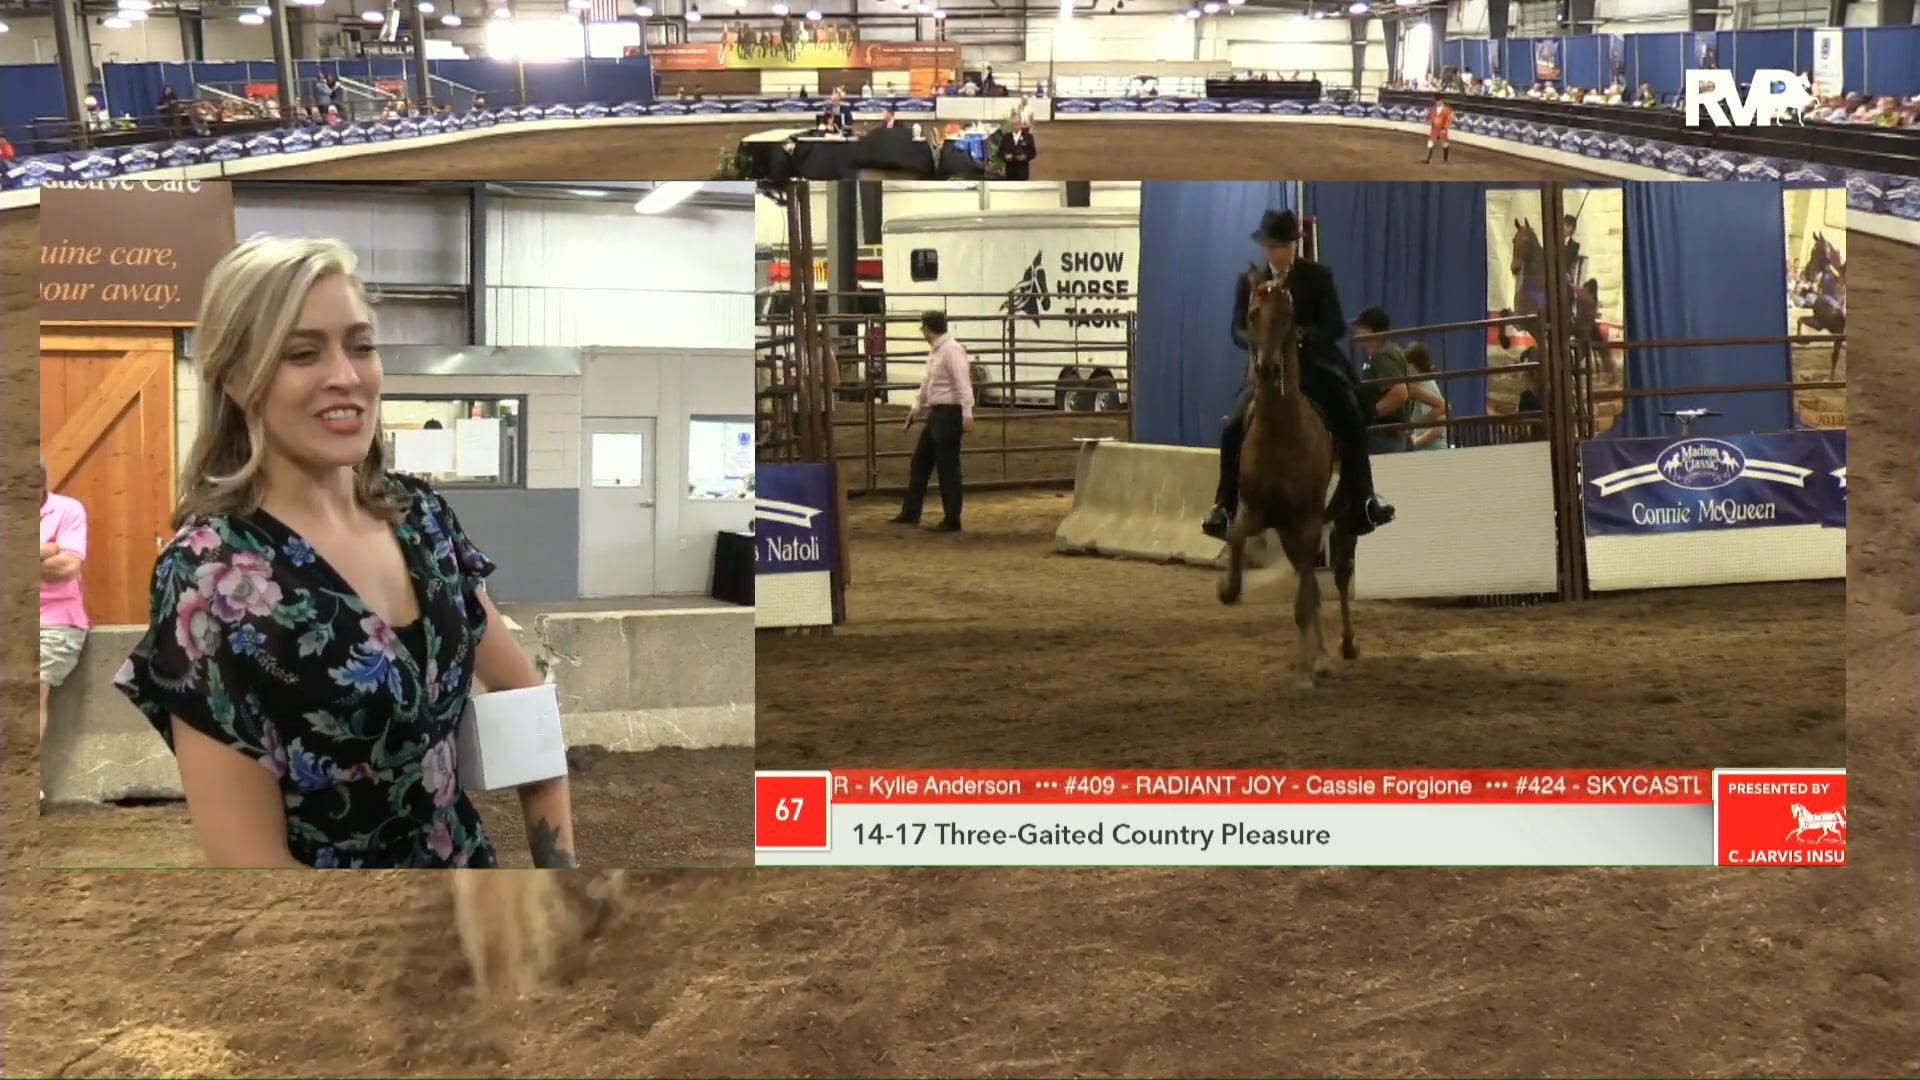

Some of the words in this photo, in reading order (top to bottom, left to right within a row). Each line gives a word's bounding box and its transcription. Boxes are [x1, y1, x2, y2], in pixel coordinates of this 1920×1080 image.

[110, 246, 177, 270] care,
[1061, 252, 1124, 273] SHOW
[102, 281, 181, 310] away.
[1057, 280, 1129, 300] HORSE
[1065, 307, 1120, 328] TACK
[1681, 444, 1721, 462] Madison
[1684, 457, 1719, 473] Classic
[1632, 501, 1691, 525] Connie
[1698, 498, 1775, 524] McQueen
[766, 536, 819, 562] Natoli
